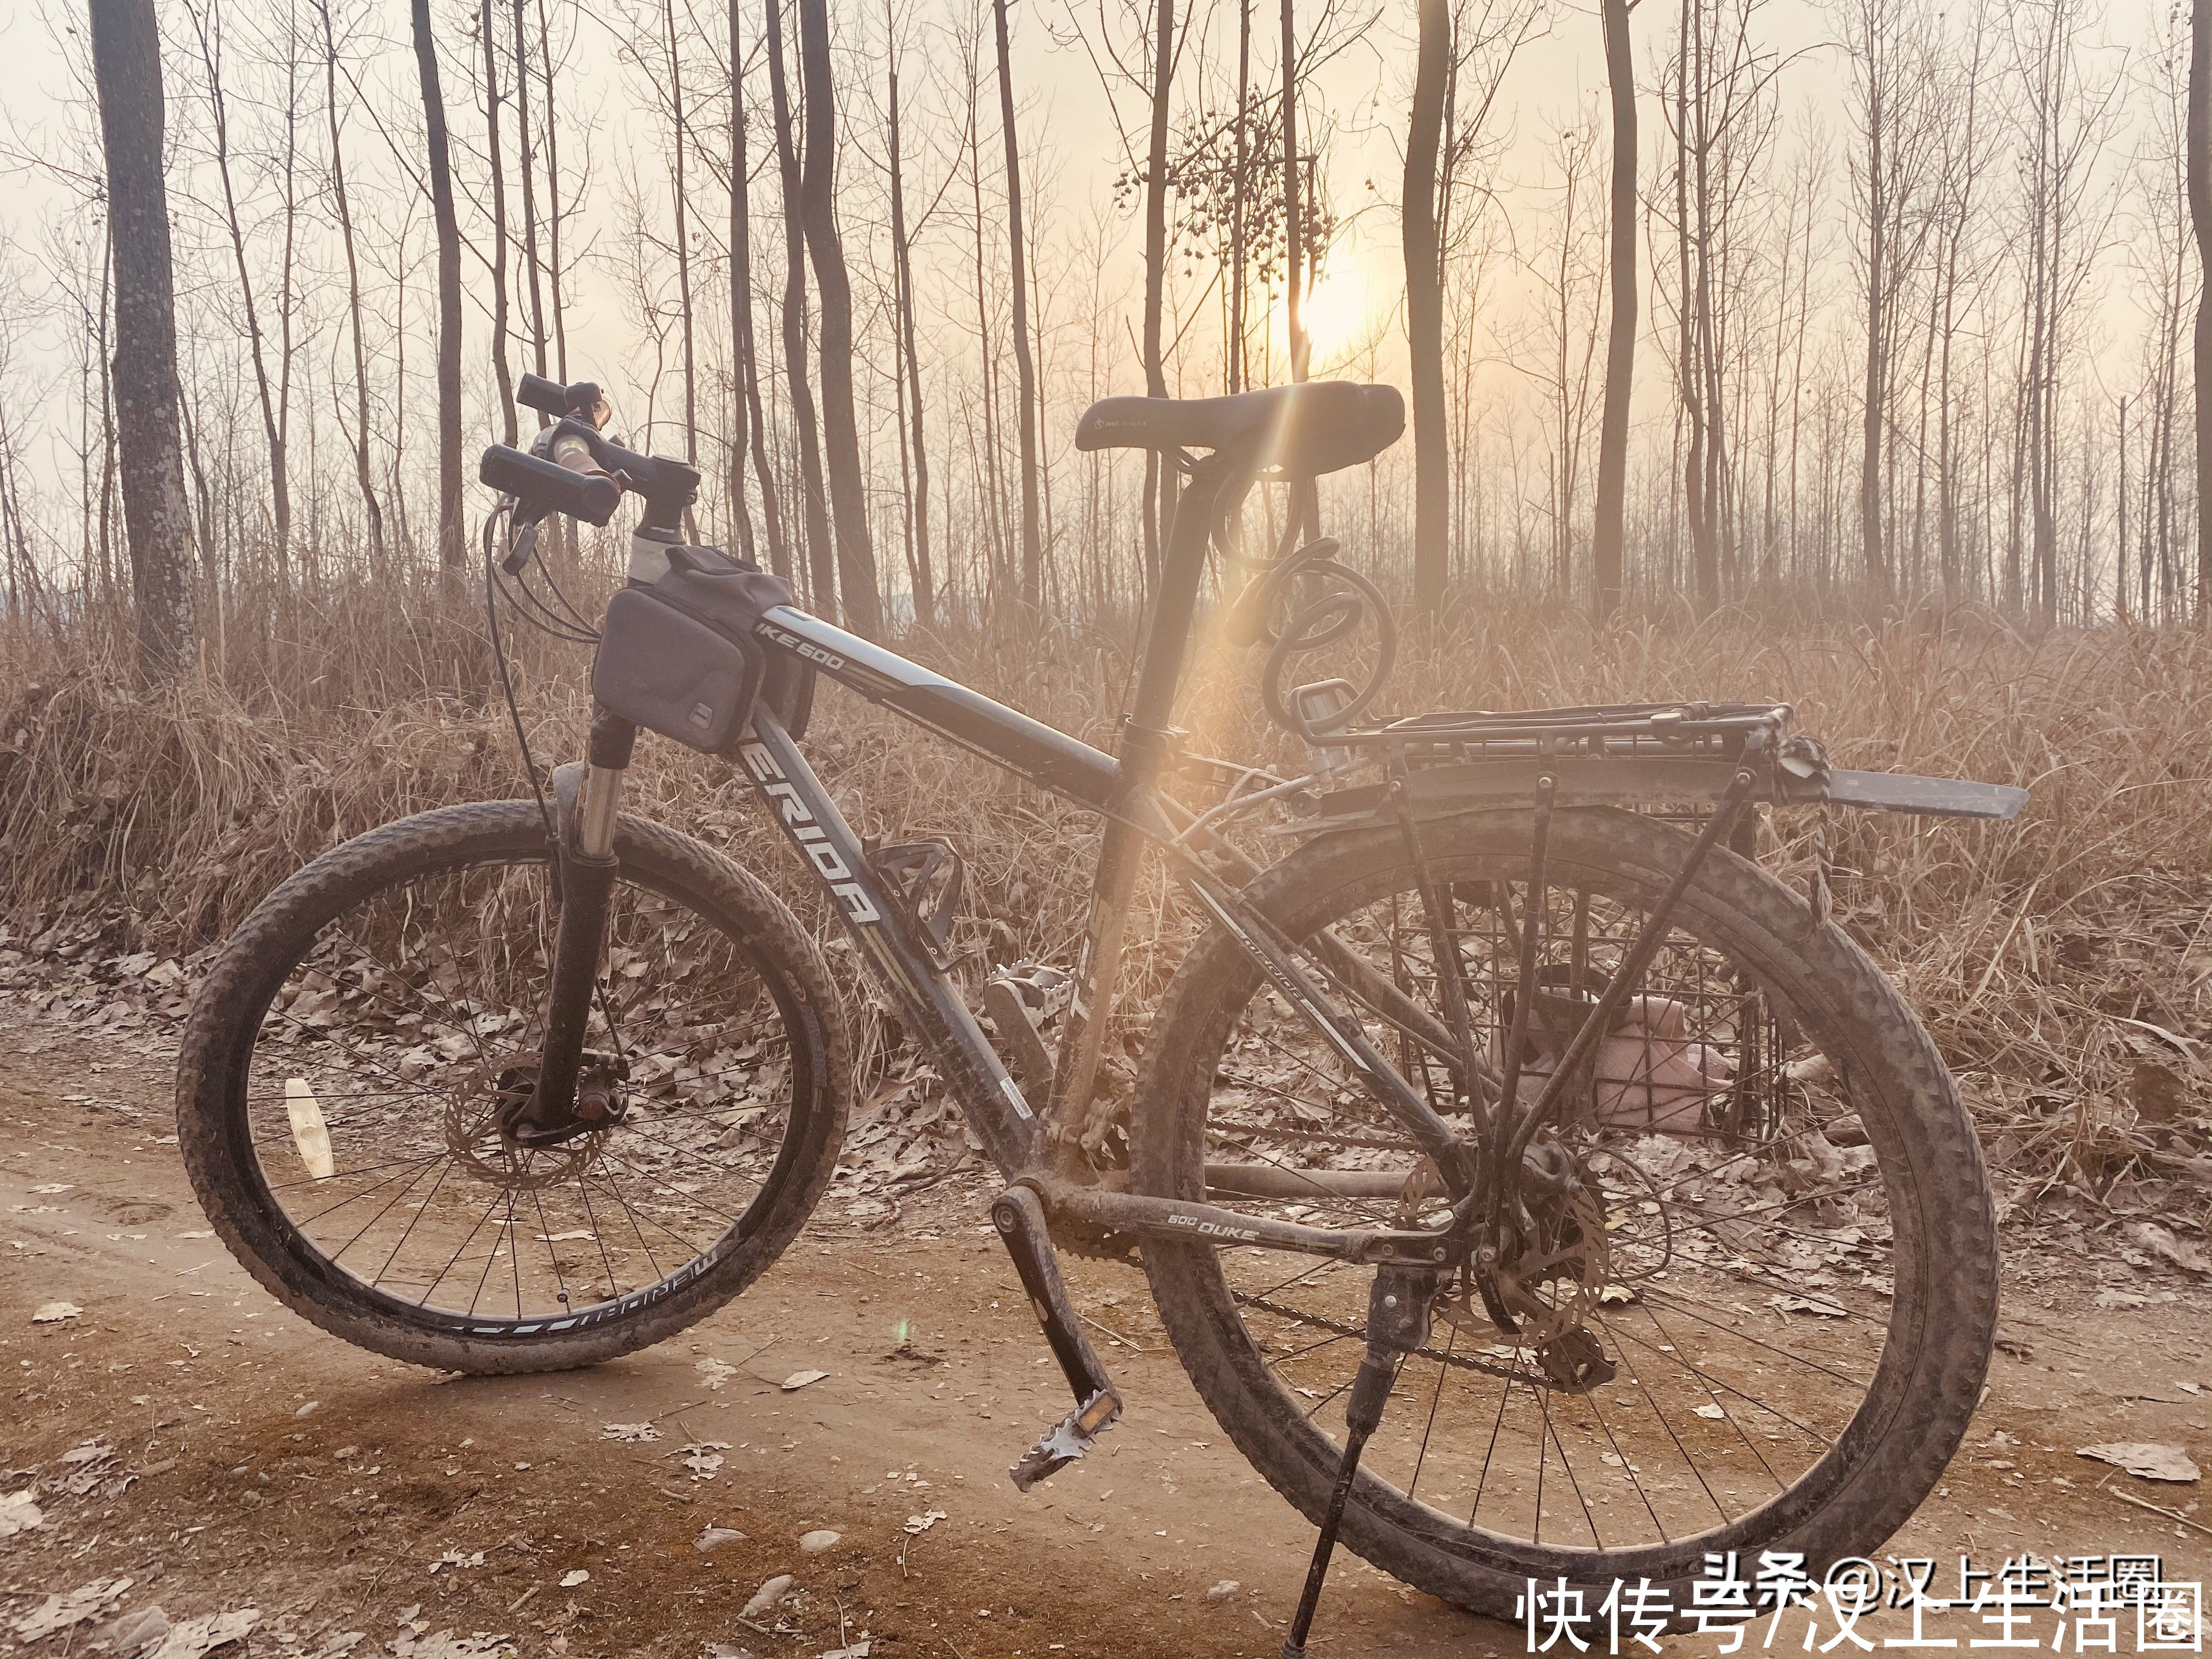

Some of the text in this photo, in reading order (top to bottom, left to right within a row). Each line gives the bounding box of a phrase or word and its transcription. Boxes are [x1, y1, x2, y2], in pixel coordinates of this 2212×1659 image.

[796, 642, 845, 670] 600
[1167, 1214, 1260, 1241] 600 DUKE
